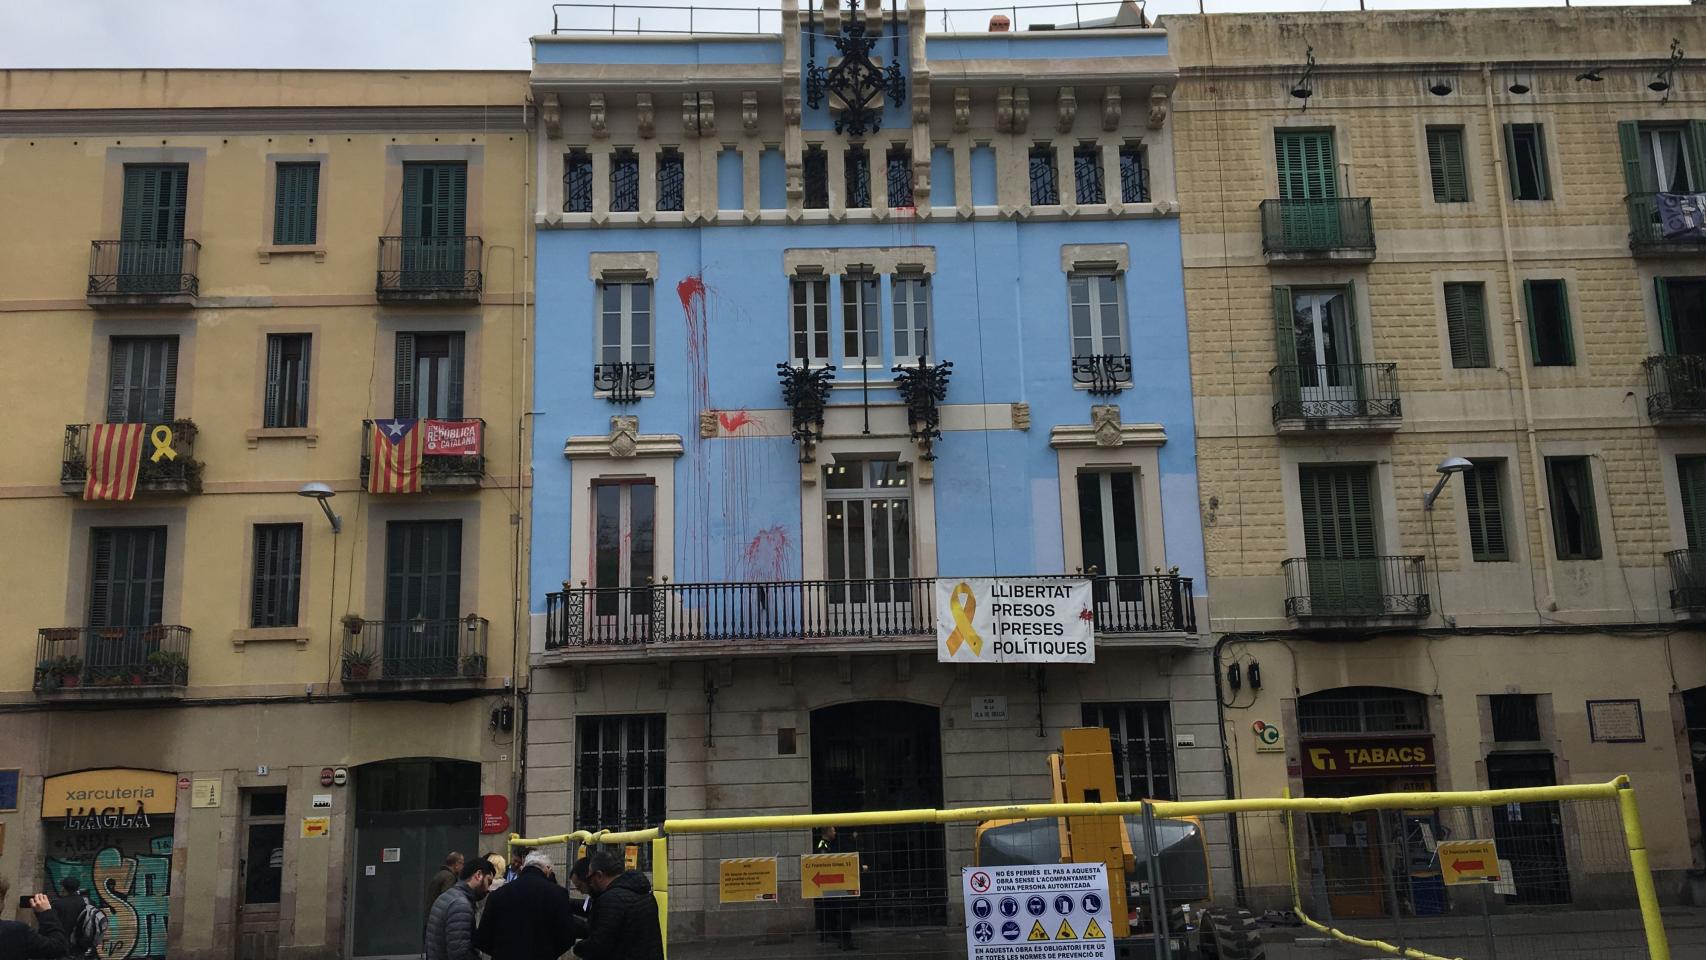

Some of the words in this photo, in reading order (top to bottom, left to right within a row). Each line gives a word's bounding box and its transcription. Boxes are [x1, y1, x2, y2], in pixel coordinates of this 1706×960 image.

[991, 585, 1073, 598] LLIBERTAT
[992, 603, 1055, 617] PRESOS
[992, 623, 996, 635] I
[1001, 622, 1064, 636] PRESES
[993, 638, 1087, 655] POLÍTIQUES
[1344, 747, 1426, 764] TABACS
[65, 786, 155, 800] xarcuteria
[986, 946, 1014, 954] AQUESTA
[1044, 944, 1082, 952] OBLIGATORI
